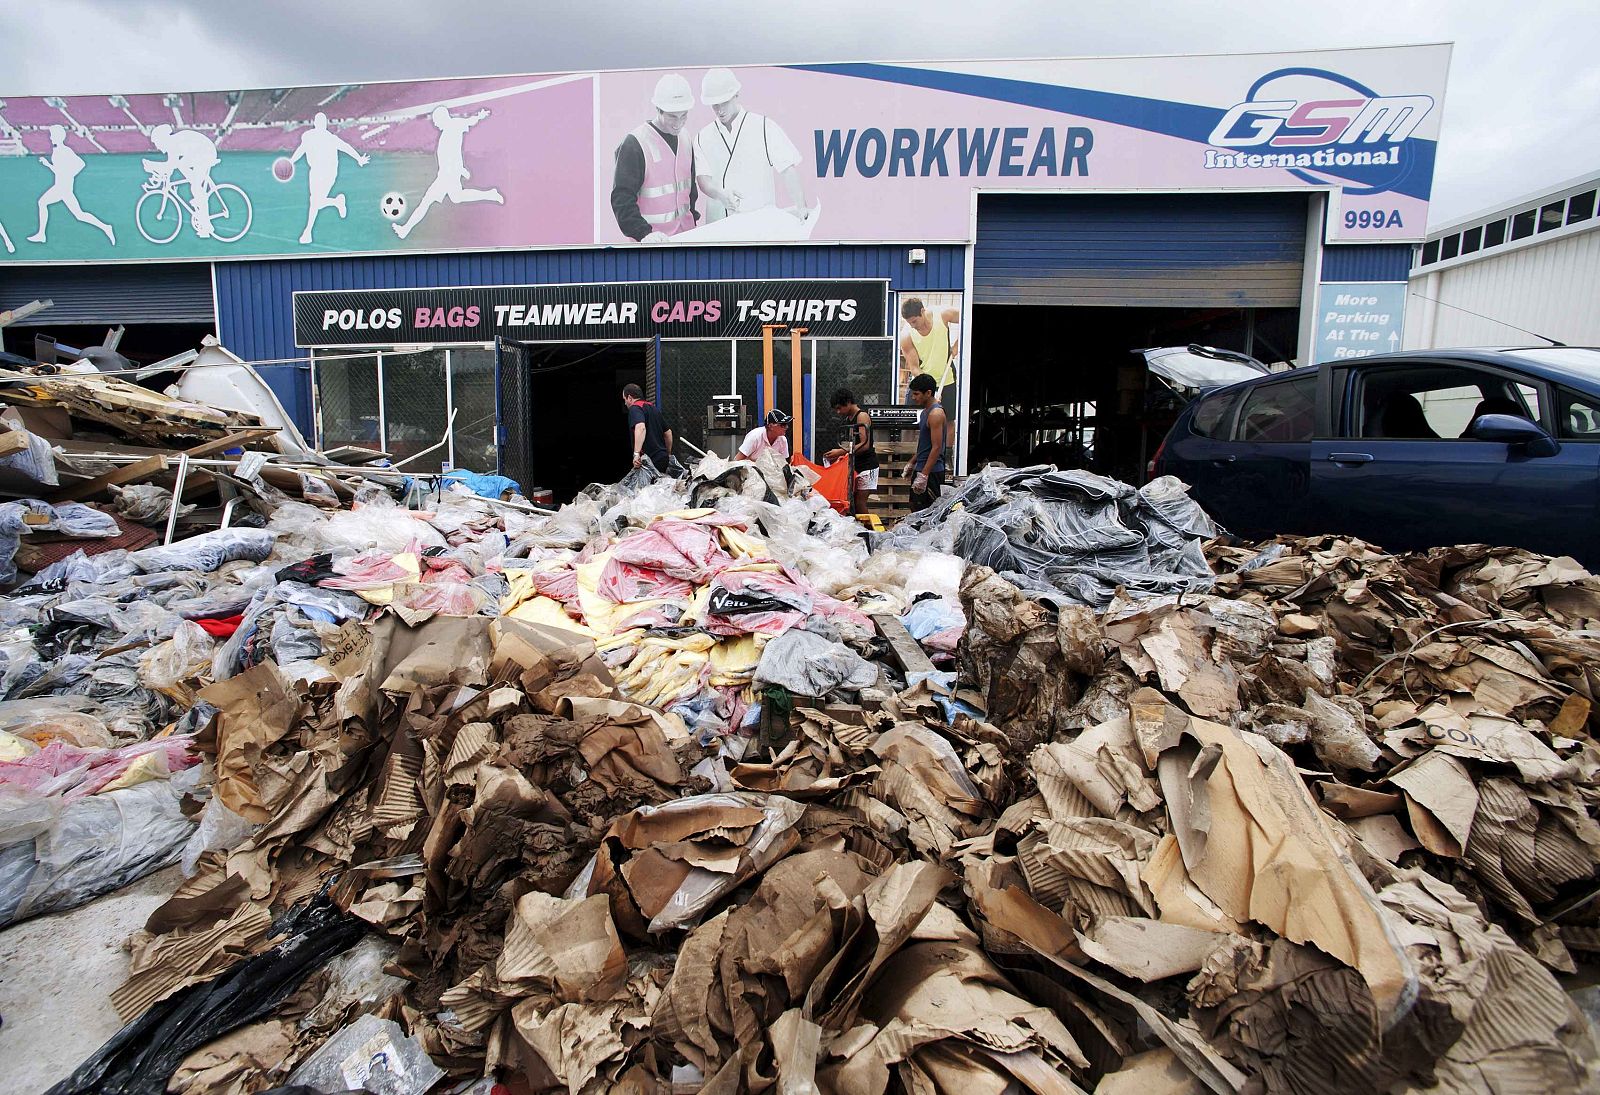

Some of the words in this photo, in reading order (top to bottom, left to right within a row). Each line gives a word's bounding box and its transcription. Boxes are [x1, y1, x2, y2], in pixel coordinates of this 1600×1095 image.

[813, 127, 1094, 178] WORKWEAR
[1204, 146, 1400, 169] International
[1344, 209, 1404, 229] 999A
[1334, 294, 1378, 306] More
[322, 308, 401, 331] POLOS
[414, 305, 480, 328] BAGS
[494, 302, 637, 326] TEAMWEAR
[651, 300, 722, 323] CAPS
[736, 299, 857, 322] T-SHIRTS
[1324, 312, 1390, 325] Parking
[1325, 329, 1345, 341] At
[1350, 329, 1381, 341] The
